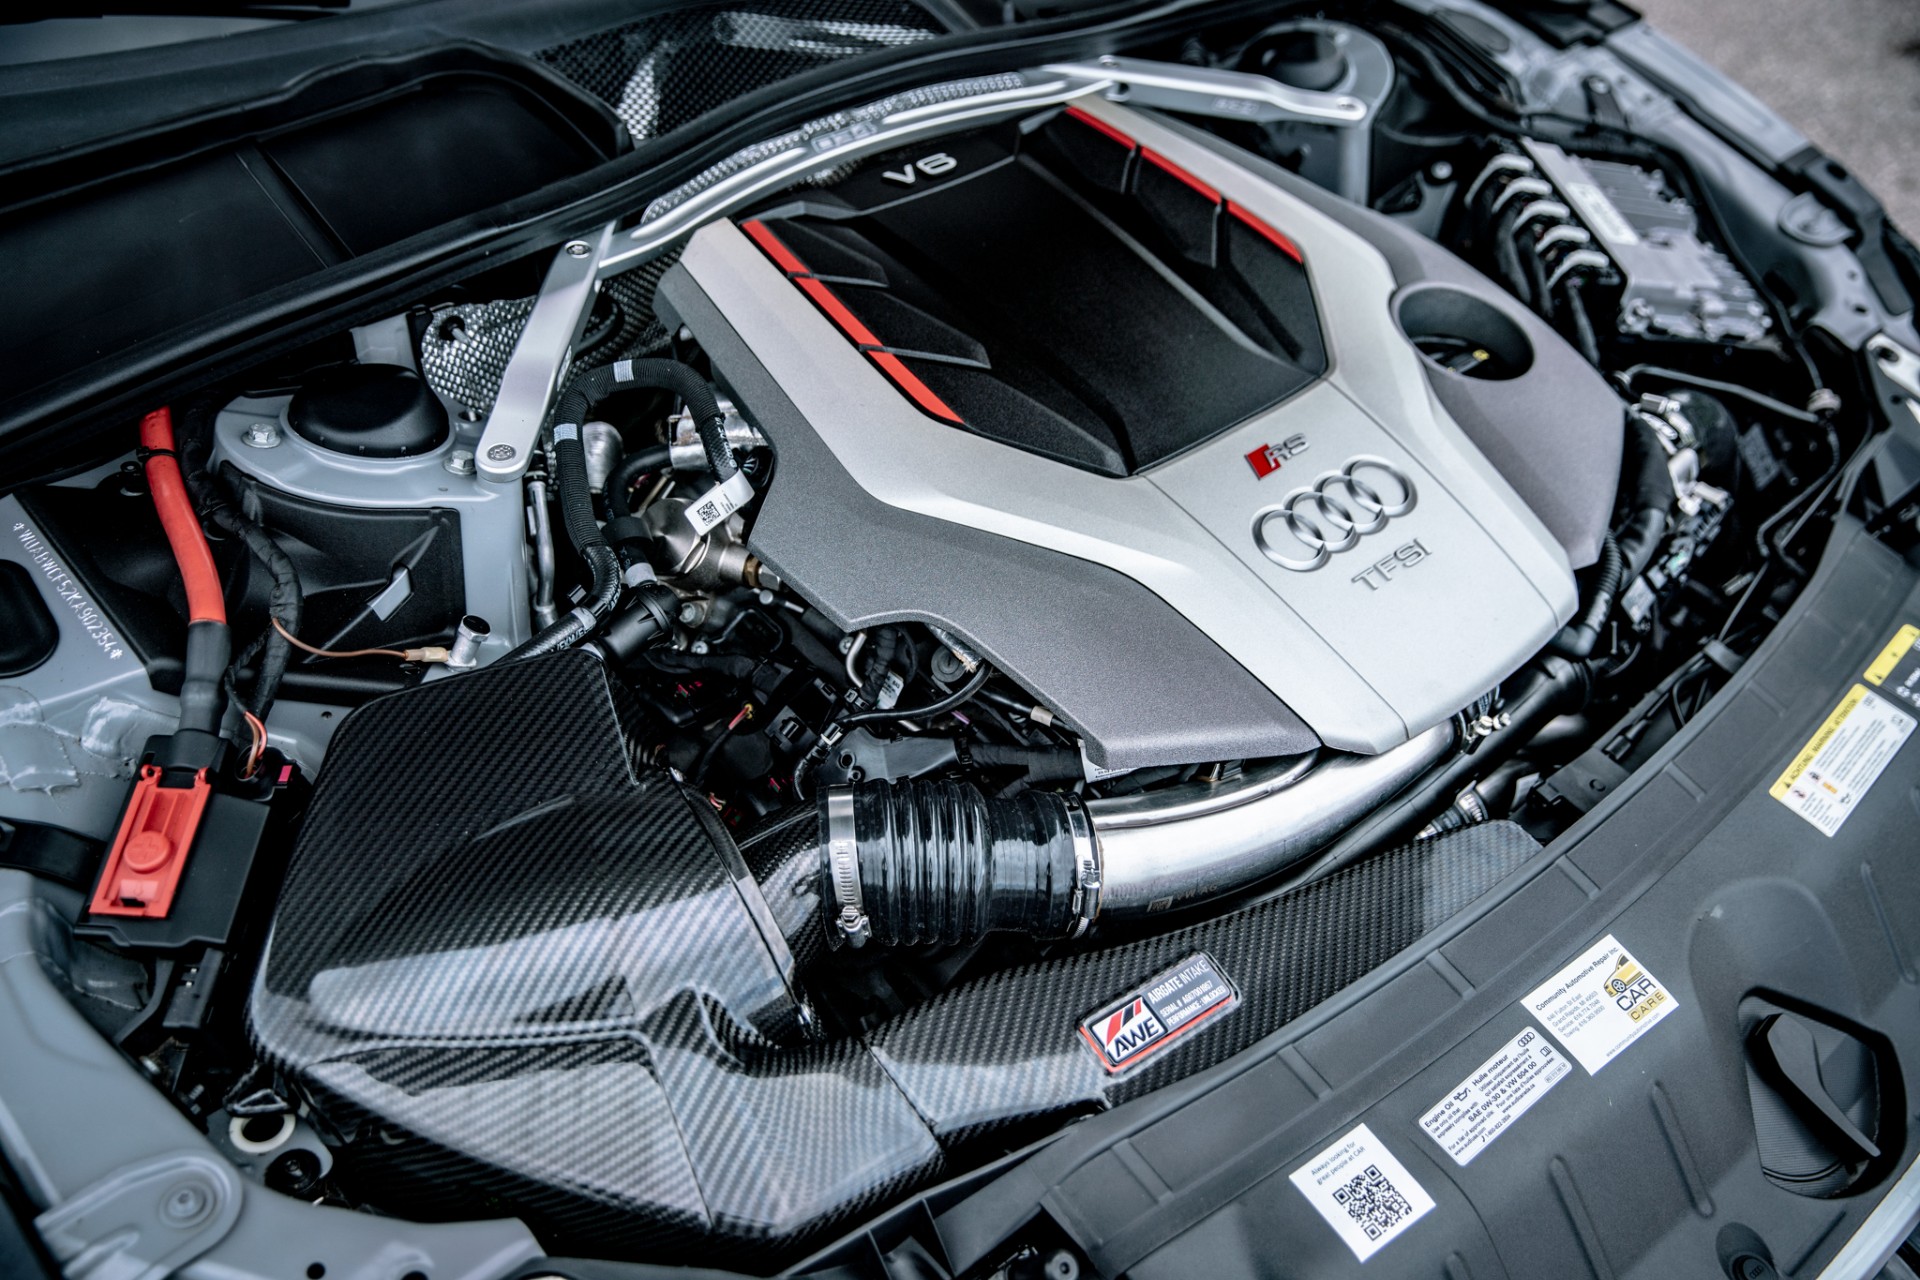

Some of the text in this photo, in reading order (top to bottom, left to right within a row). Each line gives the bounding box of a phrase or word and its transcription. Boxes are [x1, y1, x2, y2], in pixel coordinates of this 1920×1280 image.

[882, 153, 957, 184] V6
[1261, 433, 1310, 470] RS
[1351, 537, 1432, 591] TFSI
[1147, 960, 1210, 1004] AIRGATE INTAKE
[1536, 987, 1567, 1011] Community
[1564, 966, 1595, 989] Automotive
[1593, 953, 1611, 968] Repair
[1616, 978, 1656, 1012] CAR
[1160, 1002, 1179, 1017] SERIAL
[1555, 1004, 1568, 1015] Fulton
[1572, 993, 1583, 1002] East
[1630, 992, 1665, 1020] CARE
[1113, 1017, 1160, 1057] AWE
[1552, 1016, 1567, 1027] Grand
[1472, 1055, 1509, 1087] Huile moteur
[1492, 1062, 1514, 1081] uniquement
[1469, 1110, 1482, 1122] SAE
[1481, 1093, 1501, 1111] 0W-30
[1506, 1078, 1518, 1089] VW
[1517, 1069, 1529, 1079] 504
[1528, 1061, 1537, 1070] 00
[1496, 1099, 1506, 1108] Pour
[1505, 1093, 1514, 1101] une
[1425, 1101, 1454, 1128] Engine Oil
[1438, 1102, 1479, 1139] expressly complies with
[1439, 1119, 1449, 1128] only
[1452, 1107, 1461, 1116] that
[1448, 1143, 1457, 1151] For
[1469, 1117, 1487, 1134] approved
[1311, 1141, 1356, 1176] Always looking for
[1317, 1173, 1331, 1185] great
[1330, 1160, 1349, 1175] people
[1353, 1147, 1365, 1157] CAR
